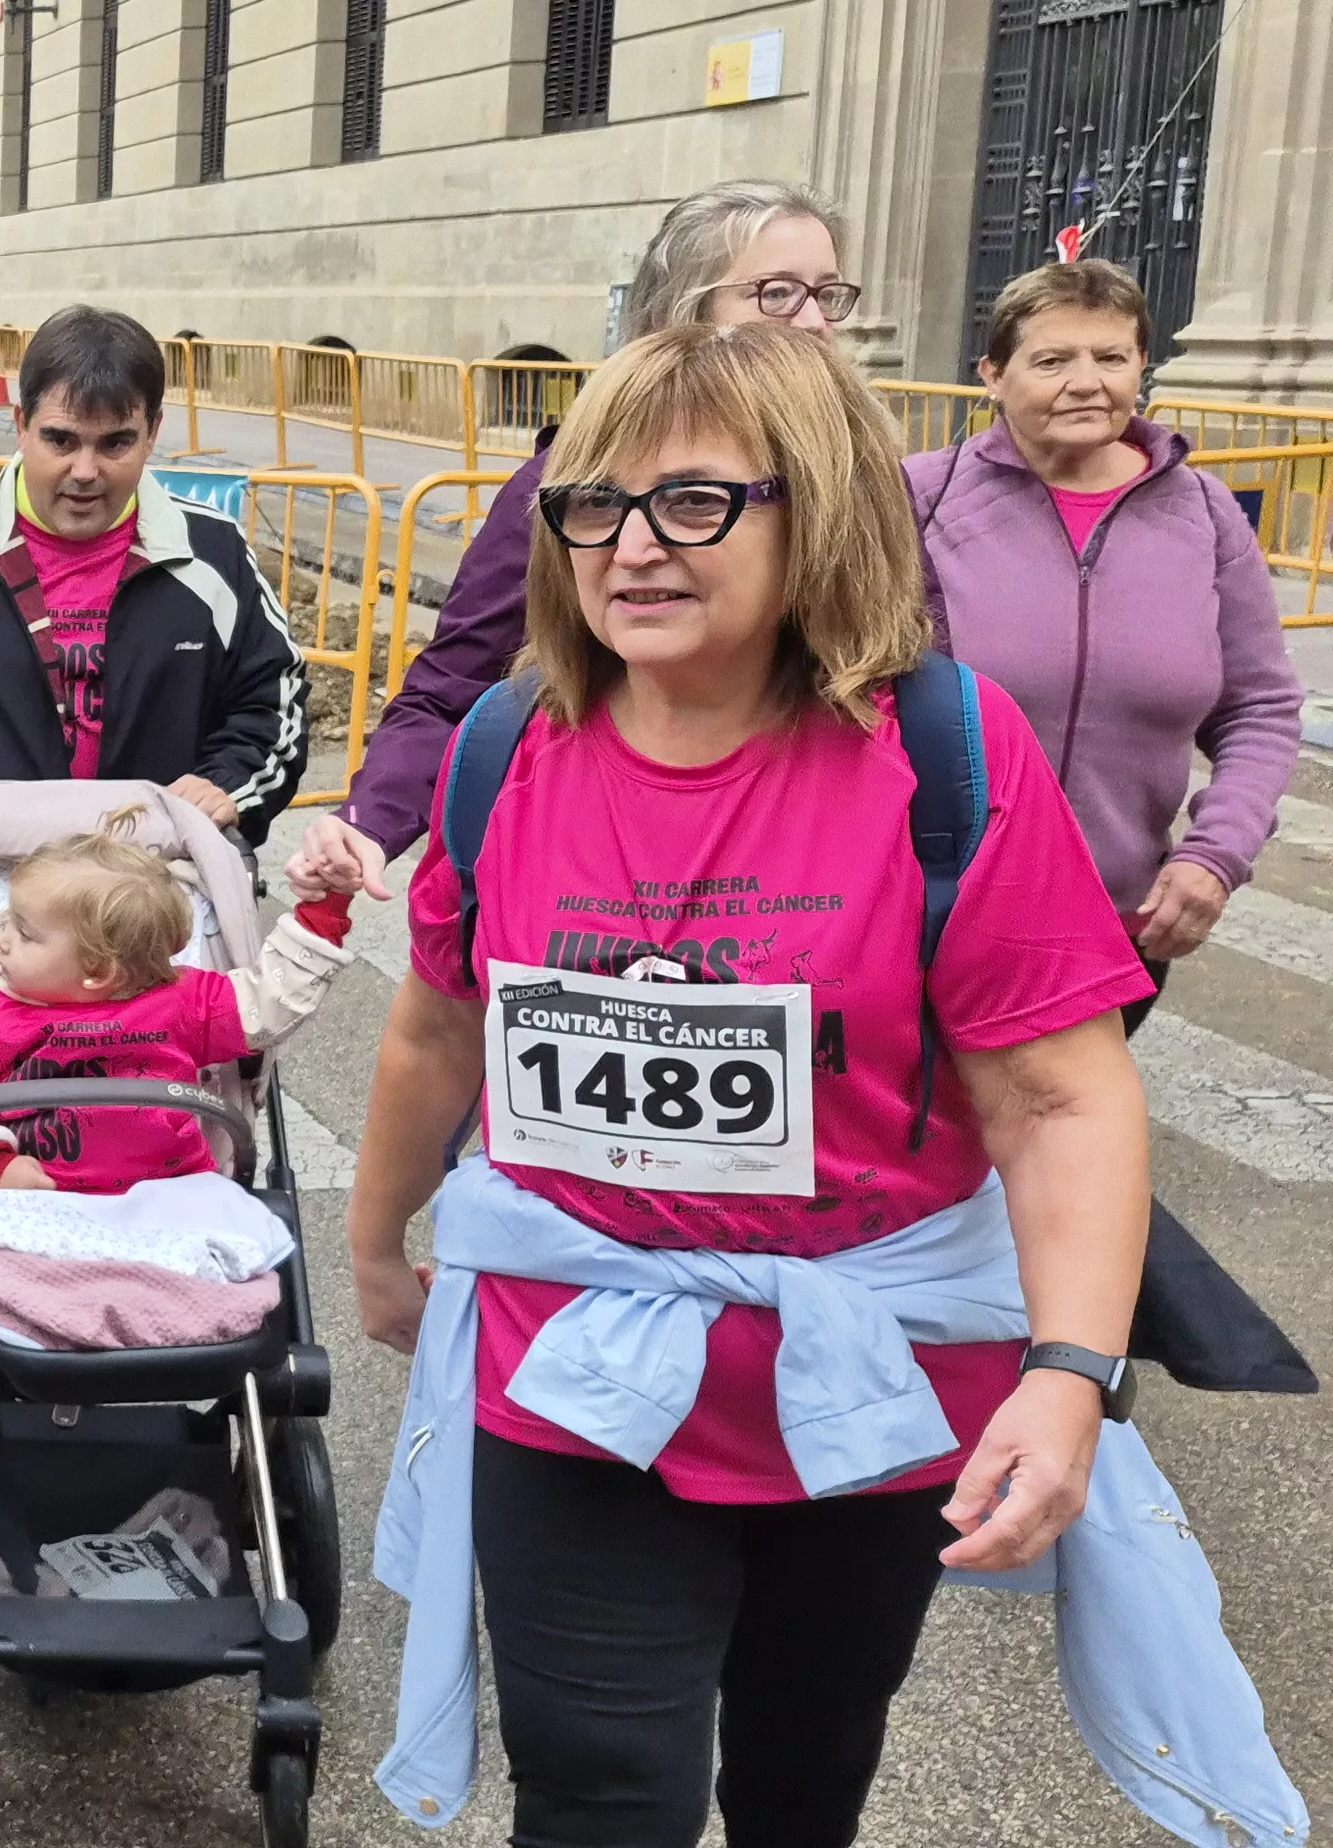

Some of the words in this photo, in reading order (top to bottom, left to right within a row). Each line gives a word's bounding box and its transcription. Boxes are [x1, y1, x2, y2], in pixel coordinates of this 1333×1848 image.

[633, 879, 659, 899] XII
[665, 876, 760, 899] CARRERA
[556, 896, 634, 917] HUESCA
[639, 900, 720, 920] CONTRA
[727, 900, 752, 916] EL
[757, 893, 844, 915] CÁNCER
[500, 989, 515, 1001] XII
[514, 984, 559, 1000] EDICIÓN
[601, 999, 673, 1023] HUESCA
[57, 1020, 122, 1032] CARRERA
[517, 1007, 619, 1038] CONTRA
[626, 1020, 652, 1042] EL
[659, 1022, 770, 1048] CÁNCER
[101, 1035, 116, 1046] EL
[517, 1042, 775, 1135] 1489
